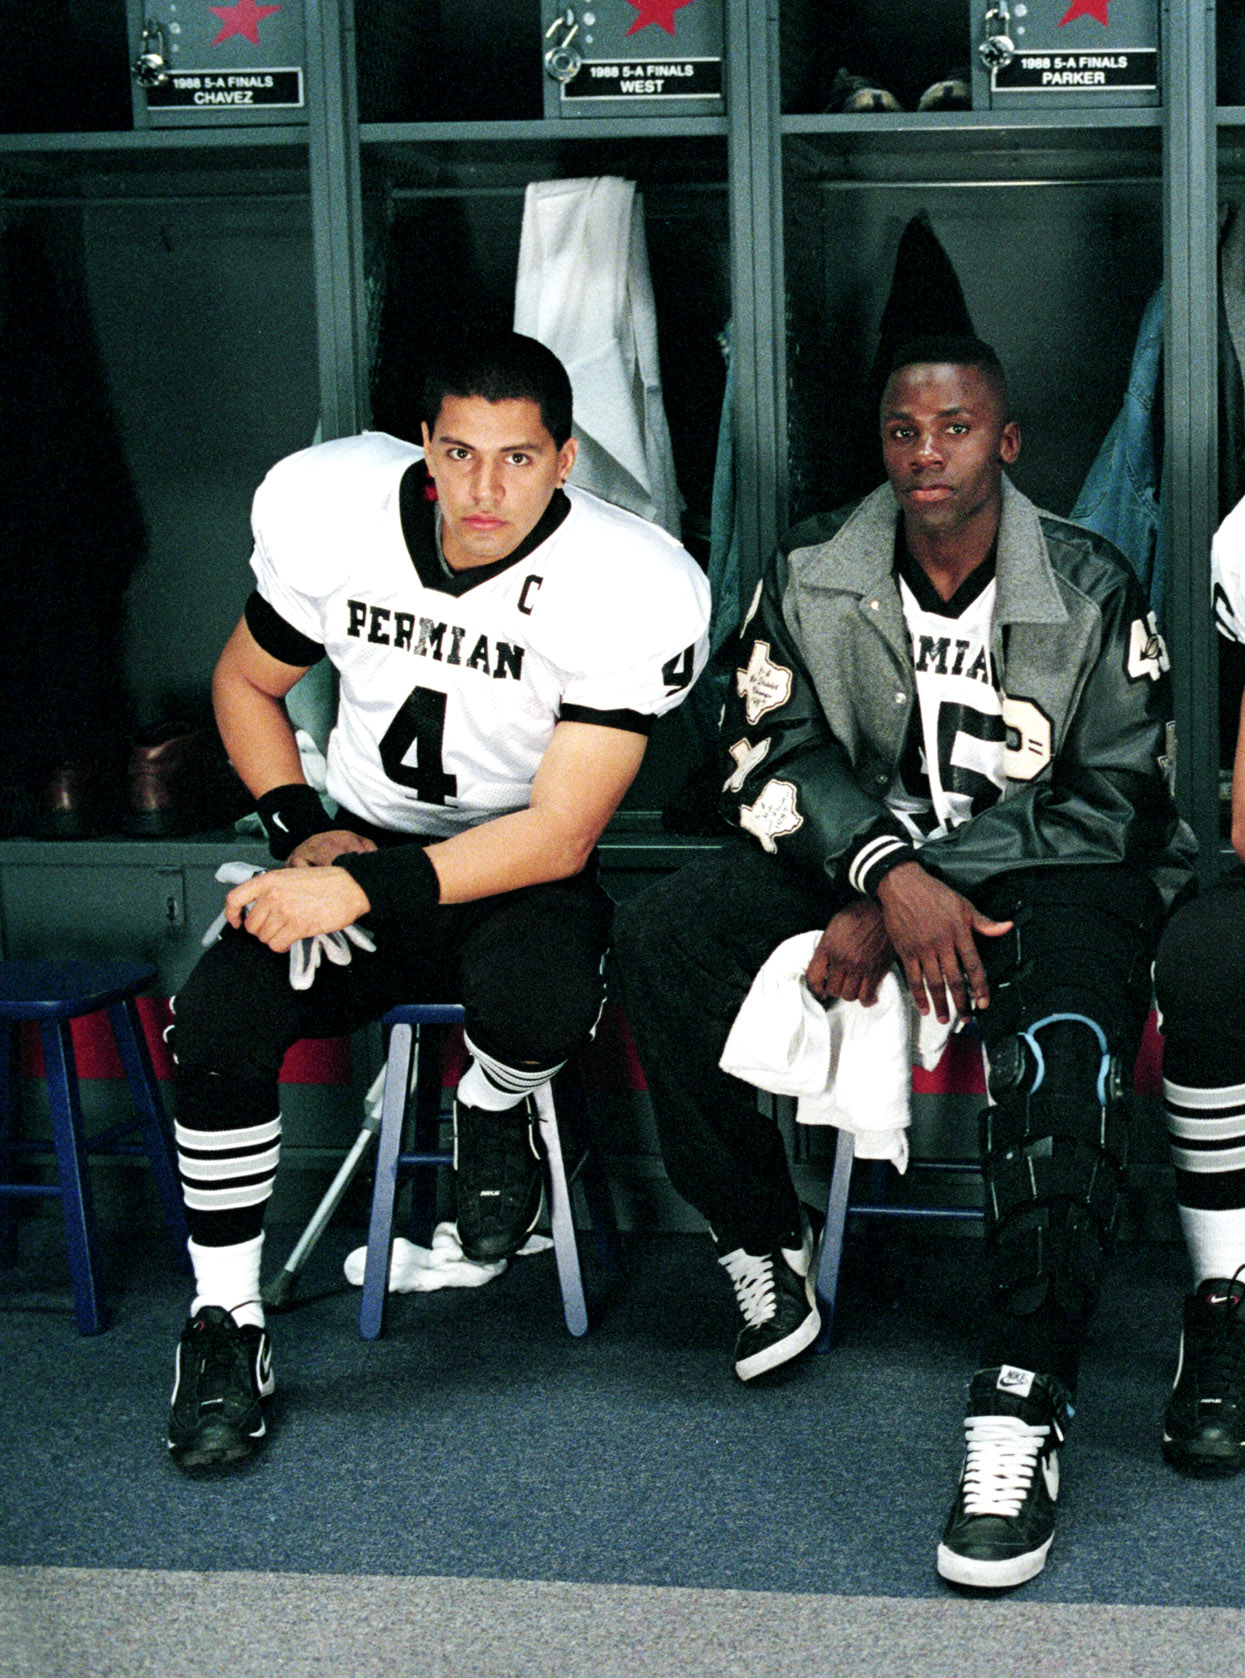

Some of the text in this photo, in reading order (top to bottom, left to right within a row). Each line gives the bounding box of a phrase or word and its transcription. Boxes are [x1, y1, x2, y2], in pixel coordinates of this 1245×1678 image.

[1021, 56, 1128, 69] 1988 5-A FINALS
[590, 64, 694, 78] 1988 5-A FINALS
[1042, 71, 1106, 85] PARKER
[173, 75, 274, 89] 1988 5-A FINALS
[620, 80, 665, 93] WEST
[193, 91, 254, 105] CHAVEZ
[517, 574, 544, 616] C
[347, 600, 525, 681] PERMIAN
[915, 634, 989, 685] MIA
[661, 642, 695, 698] 4
[378, 685, 459, 809] 4
